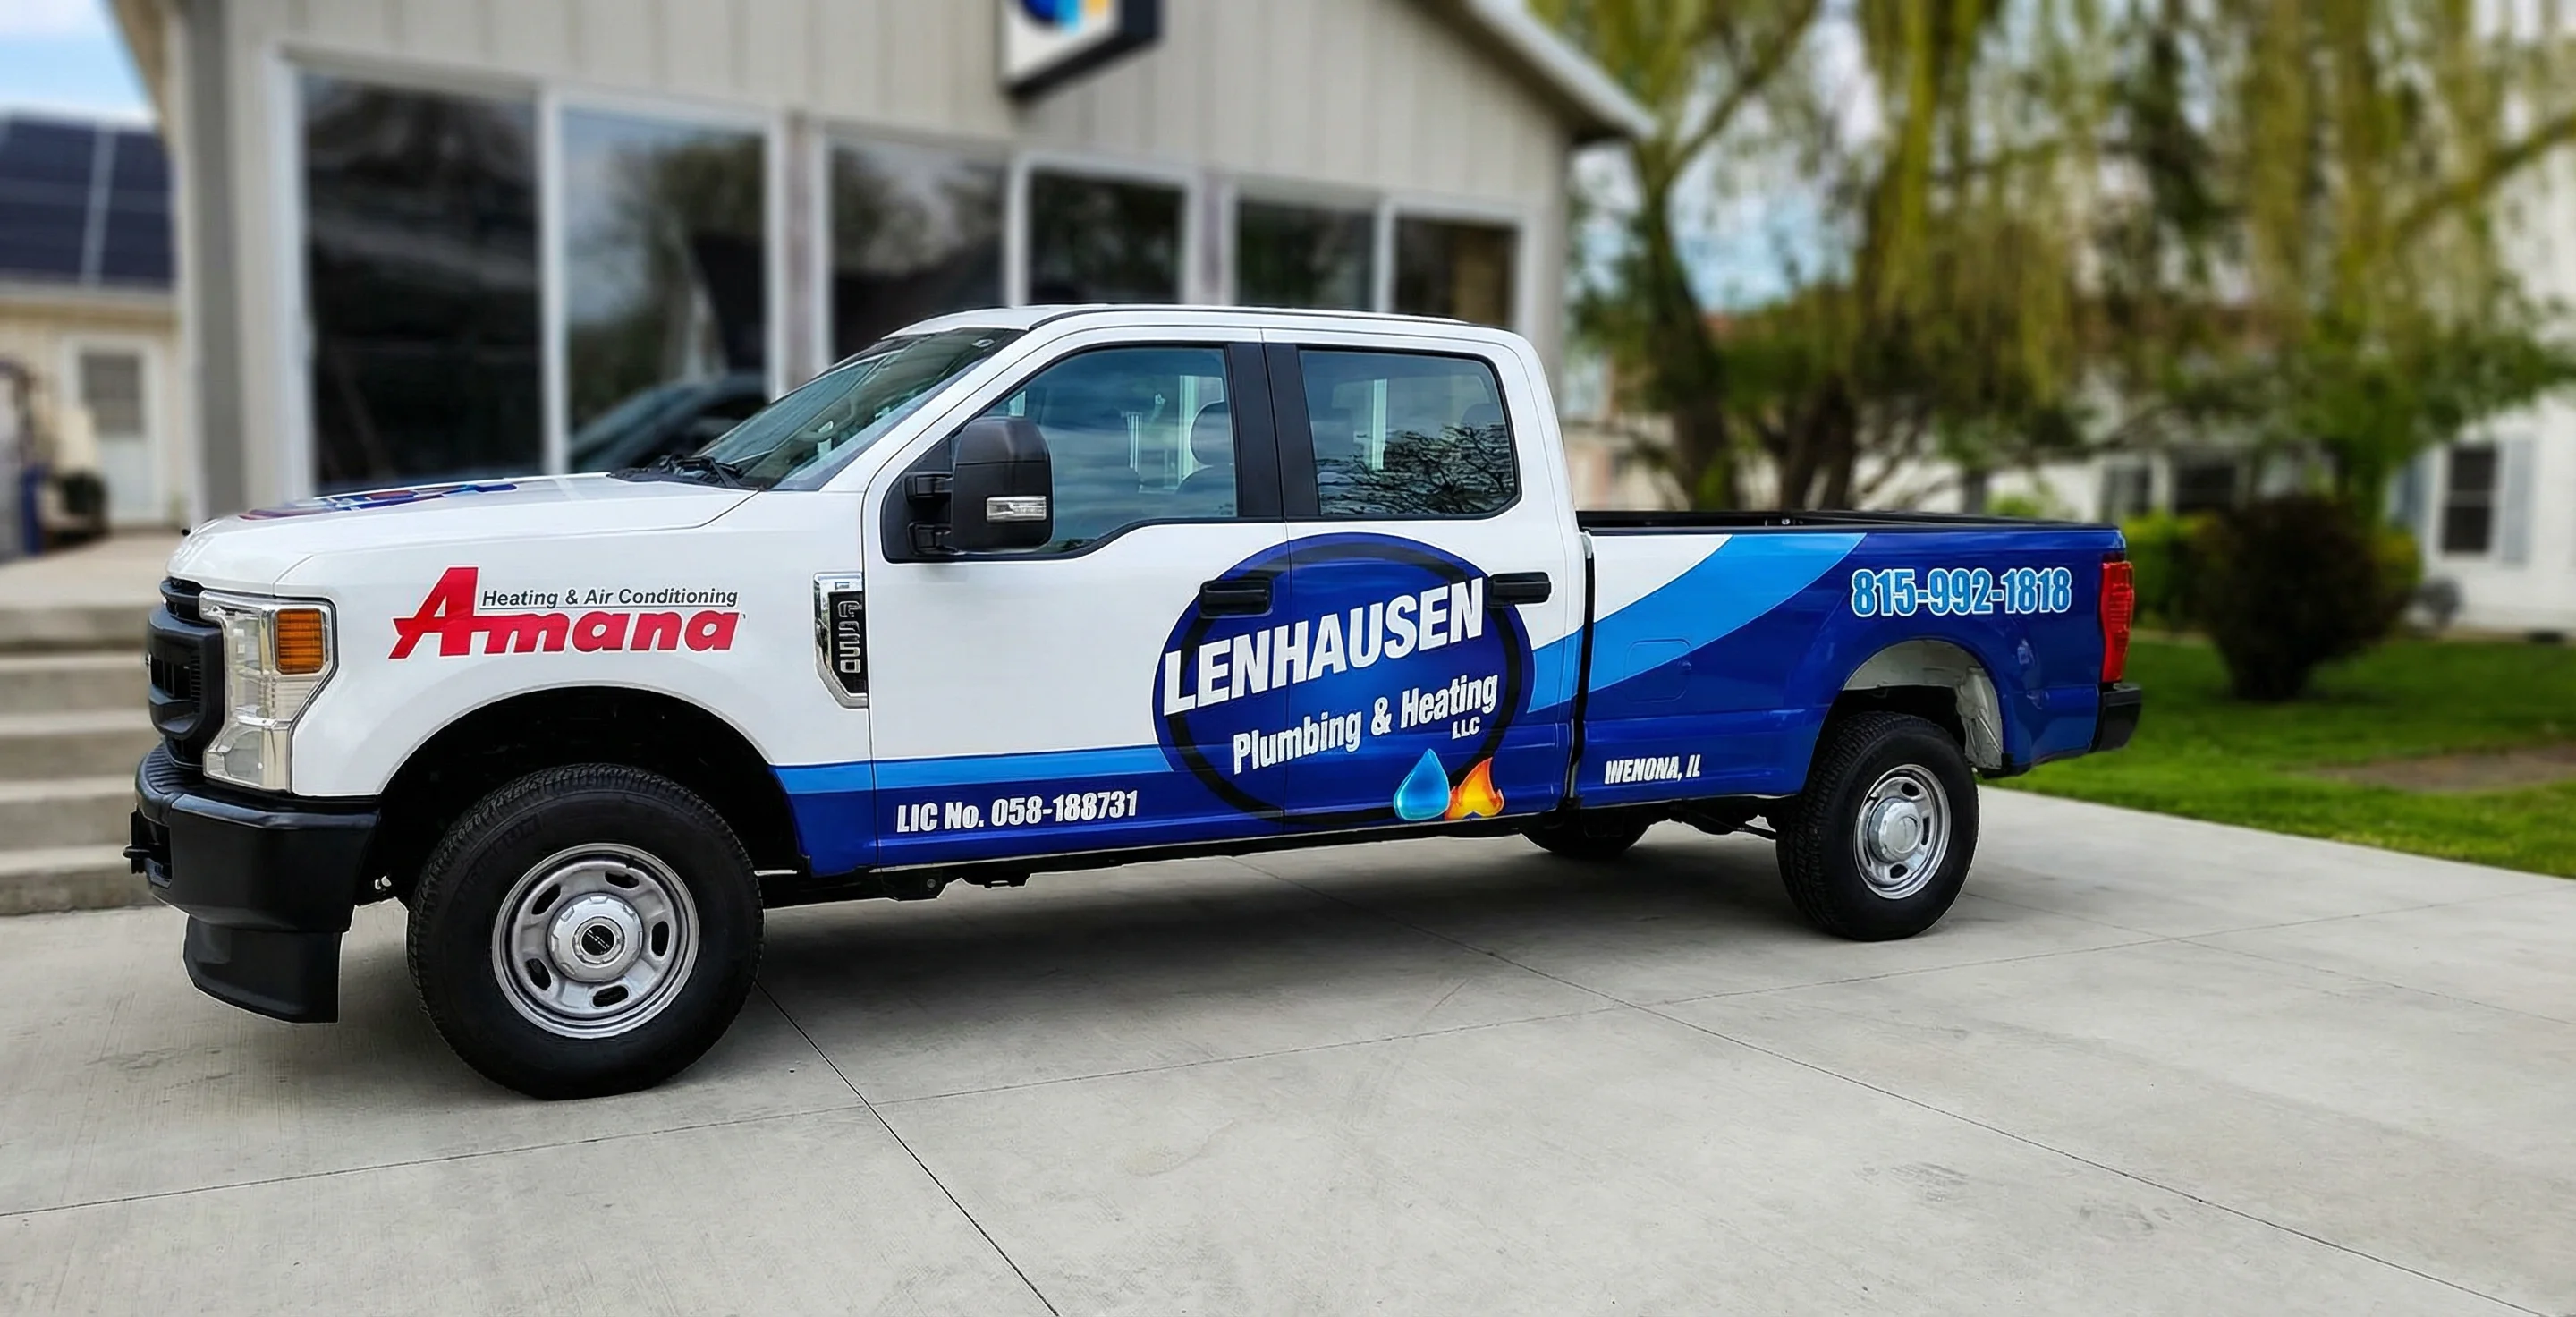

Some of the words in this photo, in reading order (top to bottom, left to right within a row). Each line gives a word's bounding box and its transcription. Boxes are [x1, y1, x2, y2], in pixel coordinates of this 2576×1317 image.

[388, 566, 741, 659] Amana
[482, 590, 558, 608] Heating
[565, 589, 579, 605] &
[584, 588, 614, 605] Air
[618, 588, 738, 608] Conditioning
[1851, 565, 2072, 617] 815-992-1818
[1164, 577, 1484, 717] LENHAUSEN
[1233, 709, 1362, 776] Plumbing
[1370, 696, 1392, 737] &
[1400, 674, 1499, 729] Heating
[1451, 716, 1481, 741] LLC
[1604, 755, 1682, 785] WENONA,
[1685, 753, 1701, 778] IL
[896, 803, 938, 833] LIC
[944, 801, 985, 830] No.
[990, 789, 1139, 828] 058-188731
